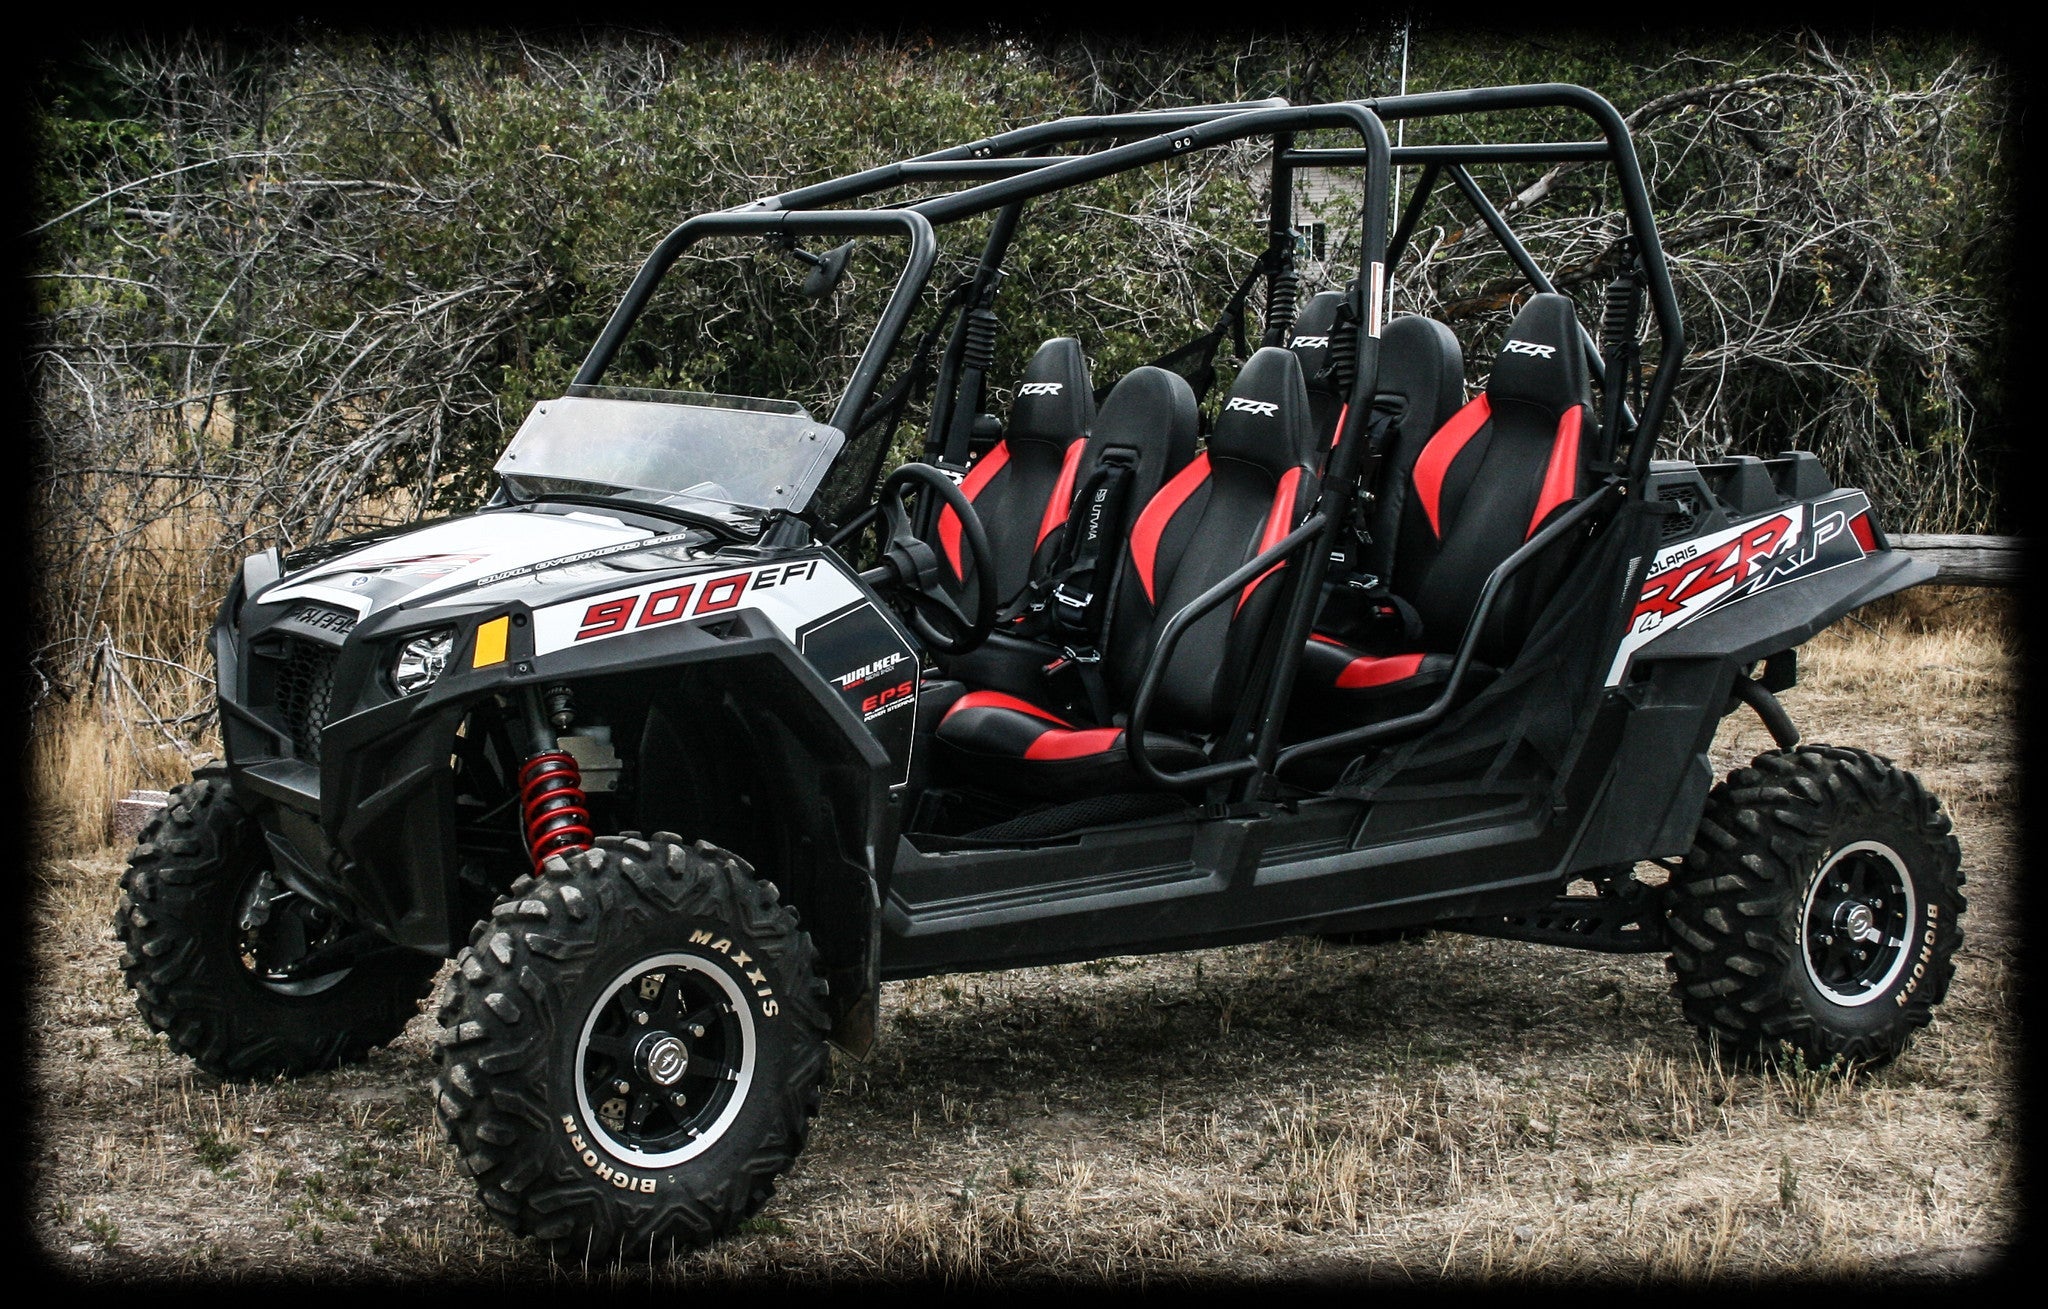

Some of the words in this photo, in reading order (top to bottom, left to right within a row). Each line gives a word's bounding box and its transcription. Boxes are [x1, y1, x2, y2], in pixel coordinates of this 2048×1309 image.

[1502, 339, 1556, 359] RZR
[1018, 382, 1063, 397] RZR
[1225, 397, 1279, 417] RZR
[1087, 504, 1102, 541] UTVMA
[1624, 513, 1793, 634] RZR
[1649, 545, 1698, 575] OLARIS
[574, 571, 752, 642] 900
[751, 561, 817, 591] EFI
[1638, 609, 1664, 634] 4
[830, 652, 910, 687] WALKER
[862, 680, 912, 712] EPS
[1895, 903, 1938, 1007] BIGHORN
[689, 929, 779, 1018] MAXXIS
[561, 1114, 657, 1194] BIGHORN
